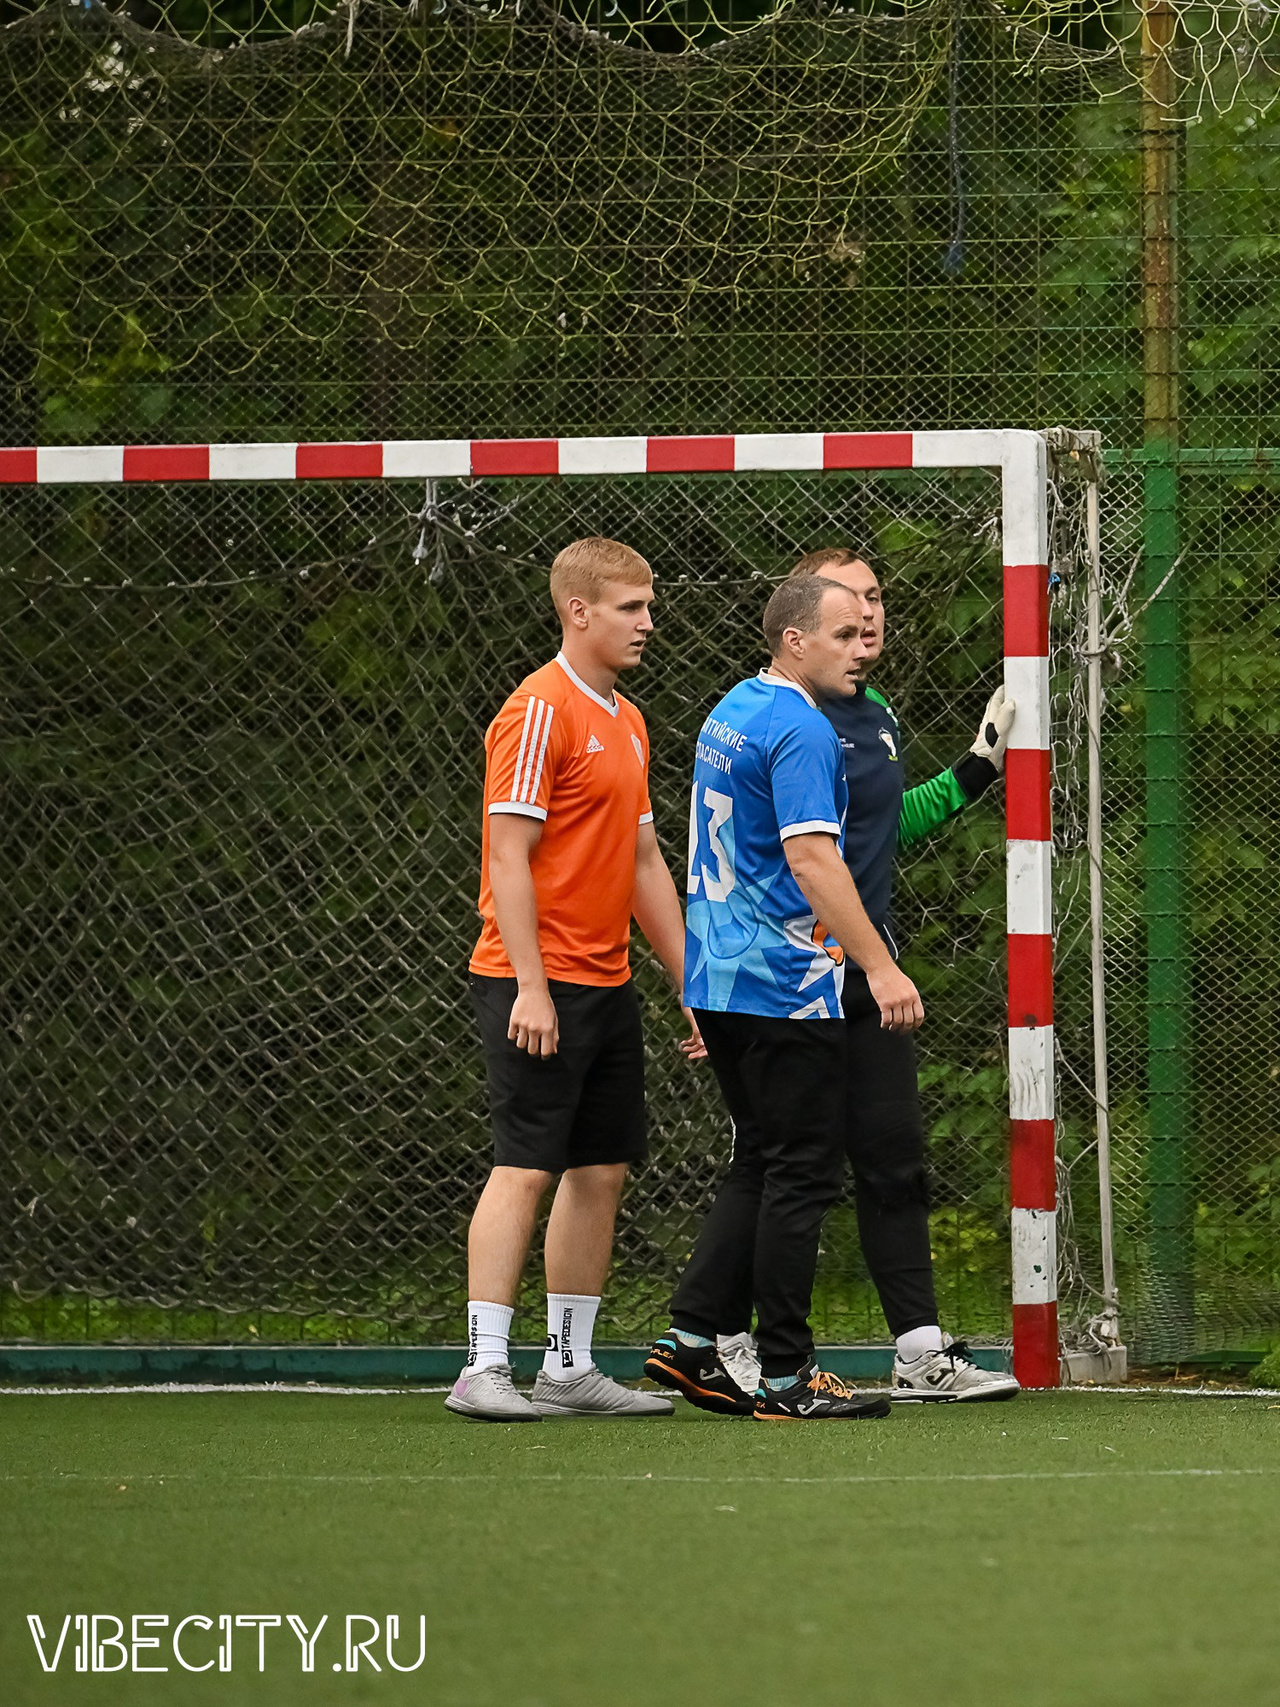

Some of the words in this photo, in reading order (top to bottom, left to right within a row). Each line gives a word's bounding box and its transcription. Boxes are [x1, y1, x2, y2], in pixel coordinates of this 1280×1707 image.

[700, 717, 748, 752] АЛТИЙСКИЕ
[687, 780, 736, 903] 13
[561, 1307, 573, 1350] TAPEDESIGN
